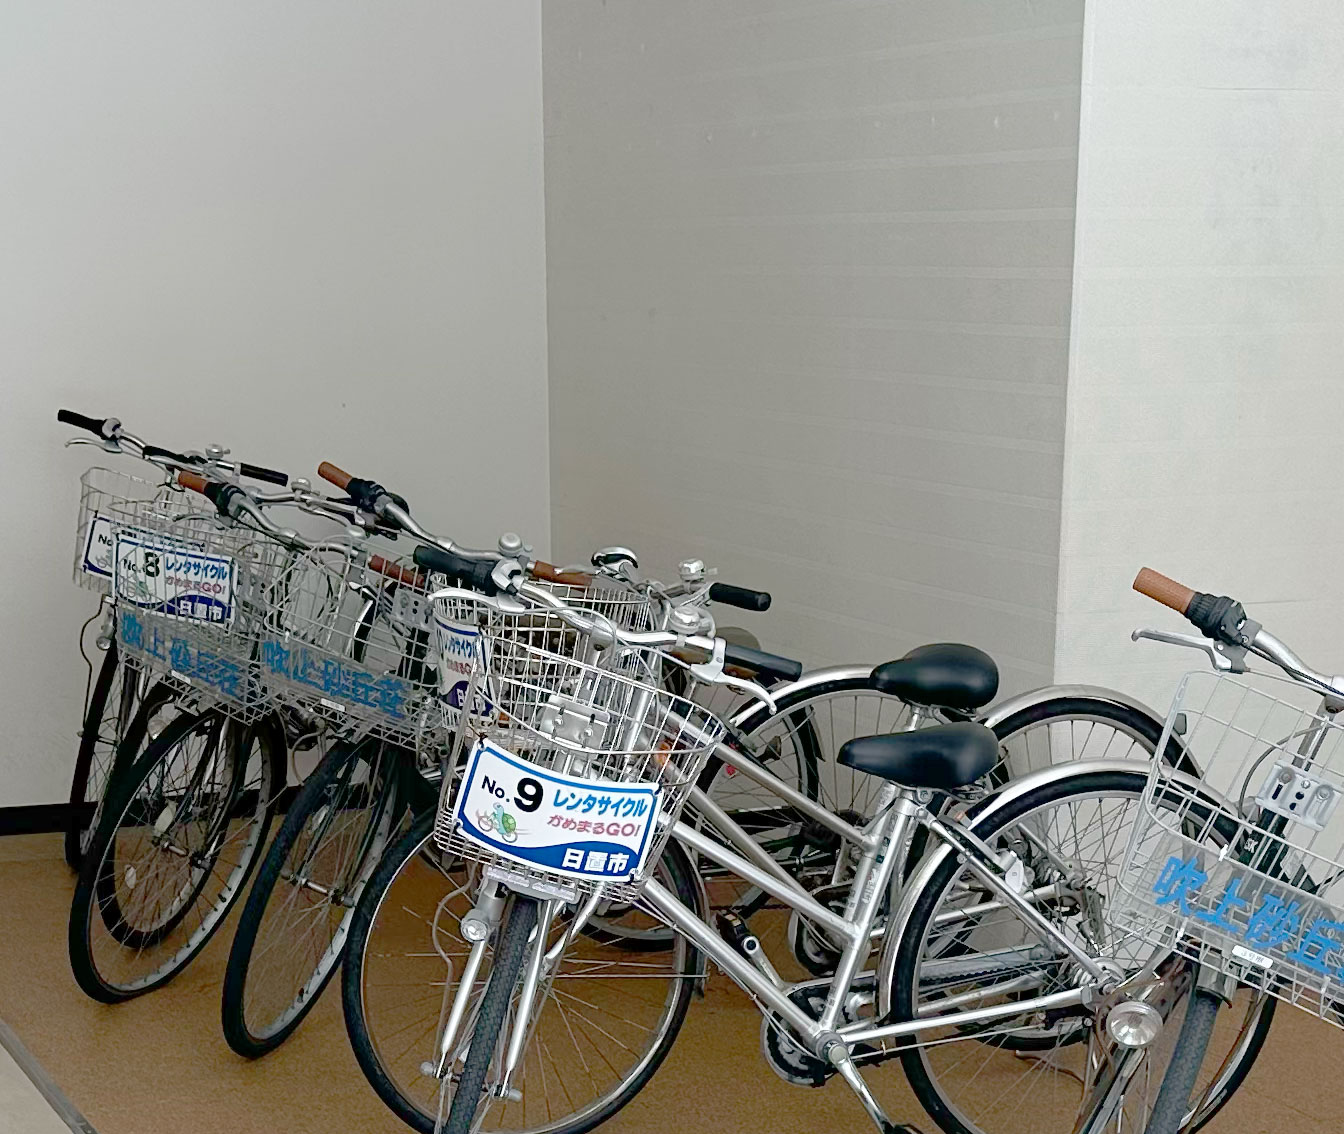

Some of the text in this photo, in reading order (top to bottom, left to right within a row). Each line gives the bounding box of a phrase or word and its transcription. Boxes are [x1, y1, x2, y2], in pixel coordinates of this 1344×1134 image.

[553, 789, 648, 818] レンタサイクル
[562, 847, 630, 874] 日置市
